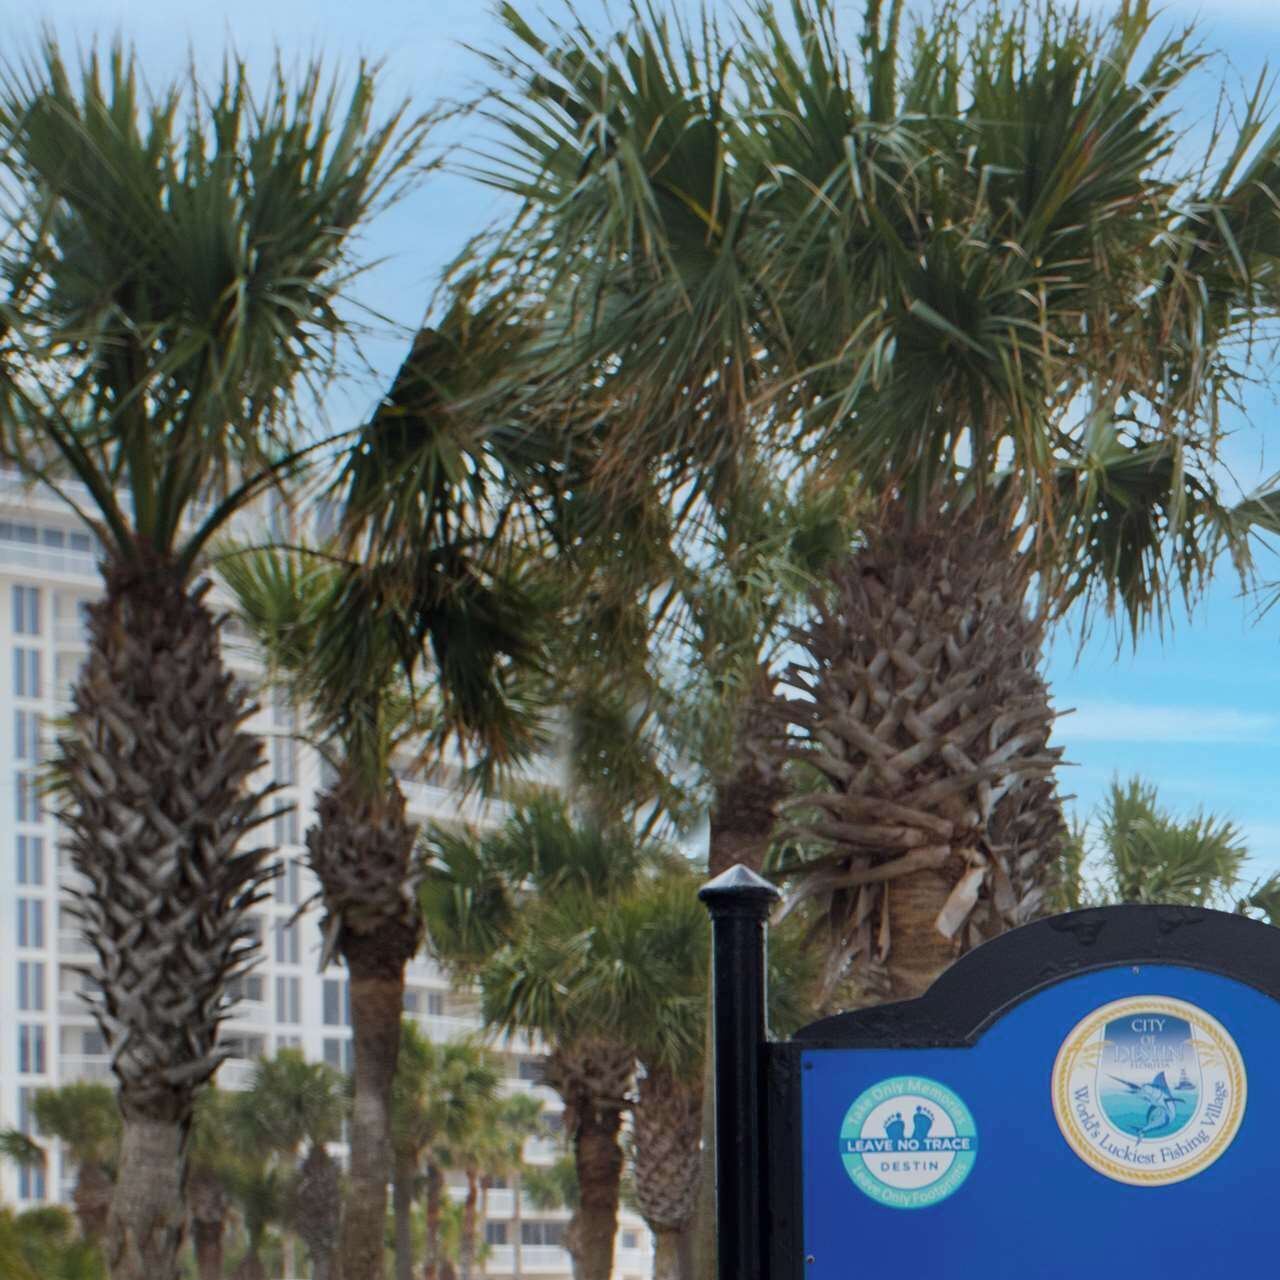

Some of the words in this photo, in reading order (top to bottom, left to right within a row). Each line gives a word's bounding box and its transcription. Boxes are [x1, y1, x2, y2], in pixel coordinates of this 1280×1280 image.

[1131, 1018, 1166, 1033] CITY
[872, 1083, 904, 1099] Only
[1074, 1085, 1100, 1139] World's
[1099, 1134, 1155, 1164] Luckiest
[1160, 1129, 1210, 1163] Fishing
[1200, 1081, 1228, 1126] Village
[847, 1139, 893, 1152] LEAVE
[897, 1139, 920, 1151] NO
[923, 1138, 970, 1150] TRACE
[881, 1161, 938, 1172] DESTIN
